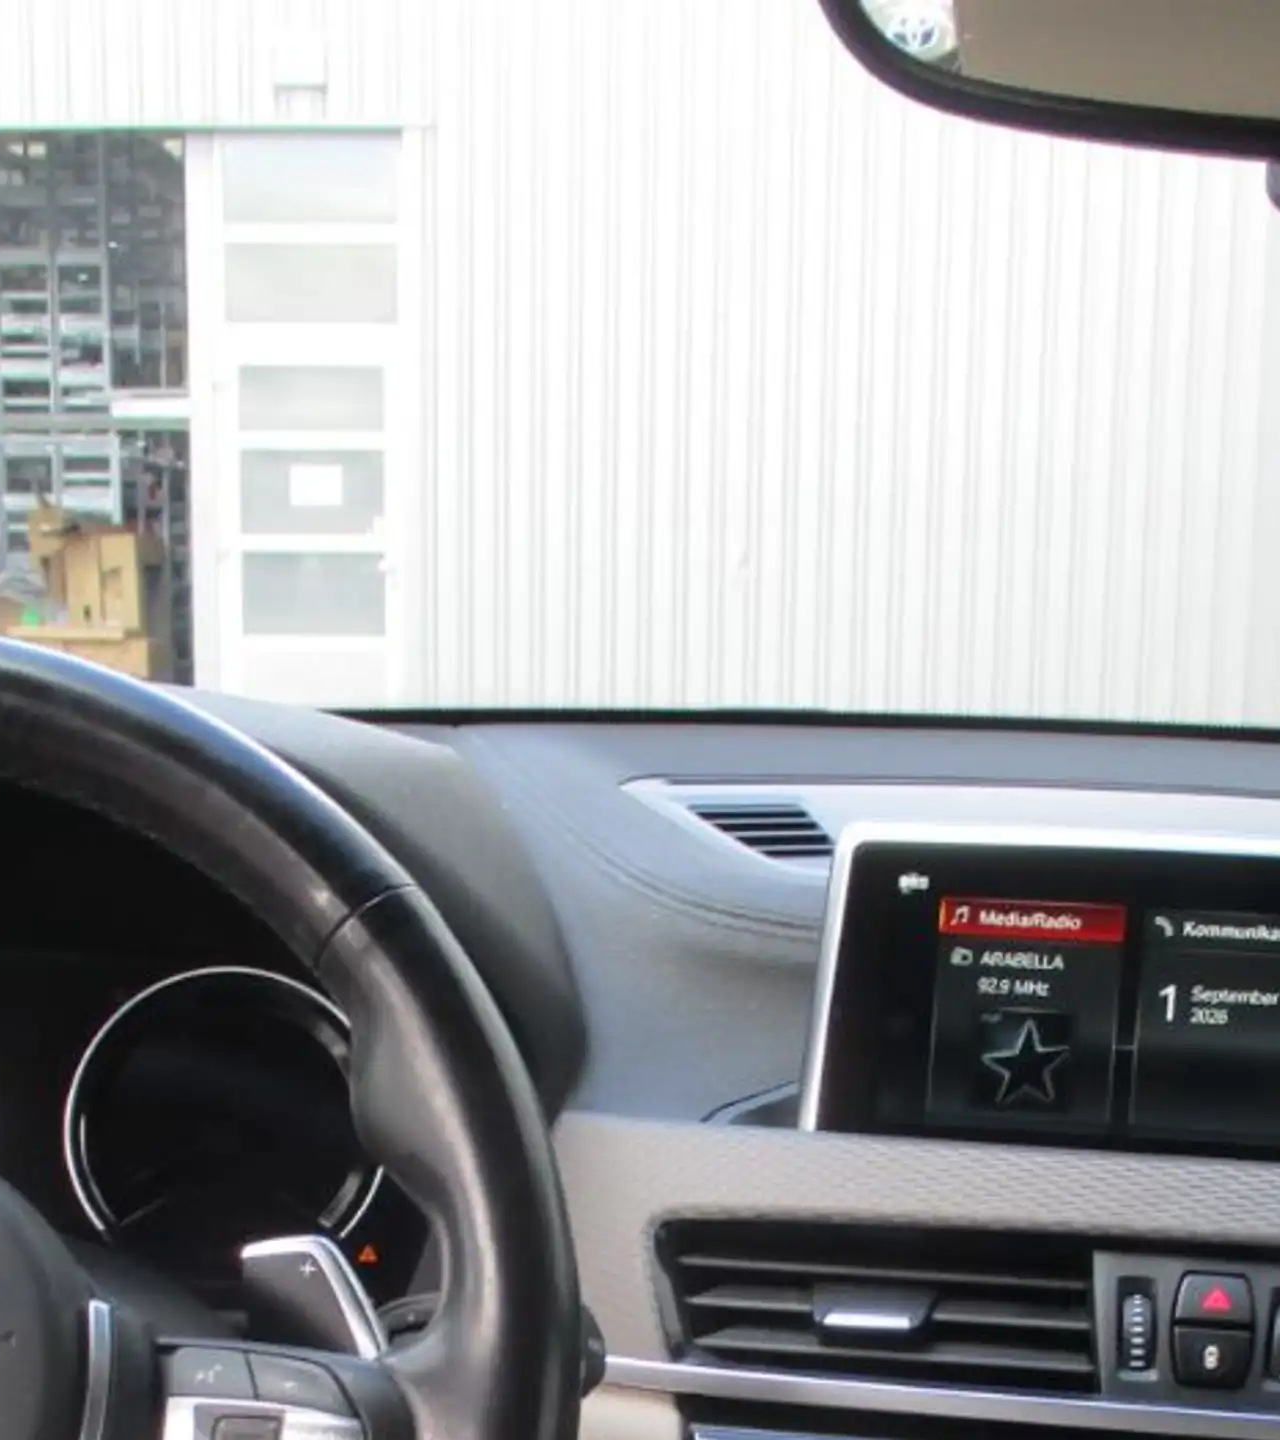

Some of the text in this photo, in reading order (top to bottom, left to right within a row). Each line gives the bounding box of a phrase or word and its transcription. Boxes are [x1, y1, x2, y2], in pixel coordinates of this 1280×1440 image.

[979, 909, 1083, 931] Media/Radio
[979, 950, 1065, 972] ARABELLA
[1013, 978, 1050, 998] MHz
[1190, 984, 1280, 1007] September
[1158, 983, 1178, 1023] 1
